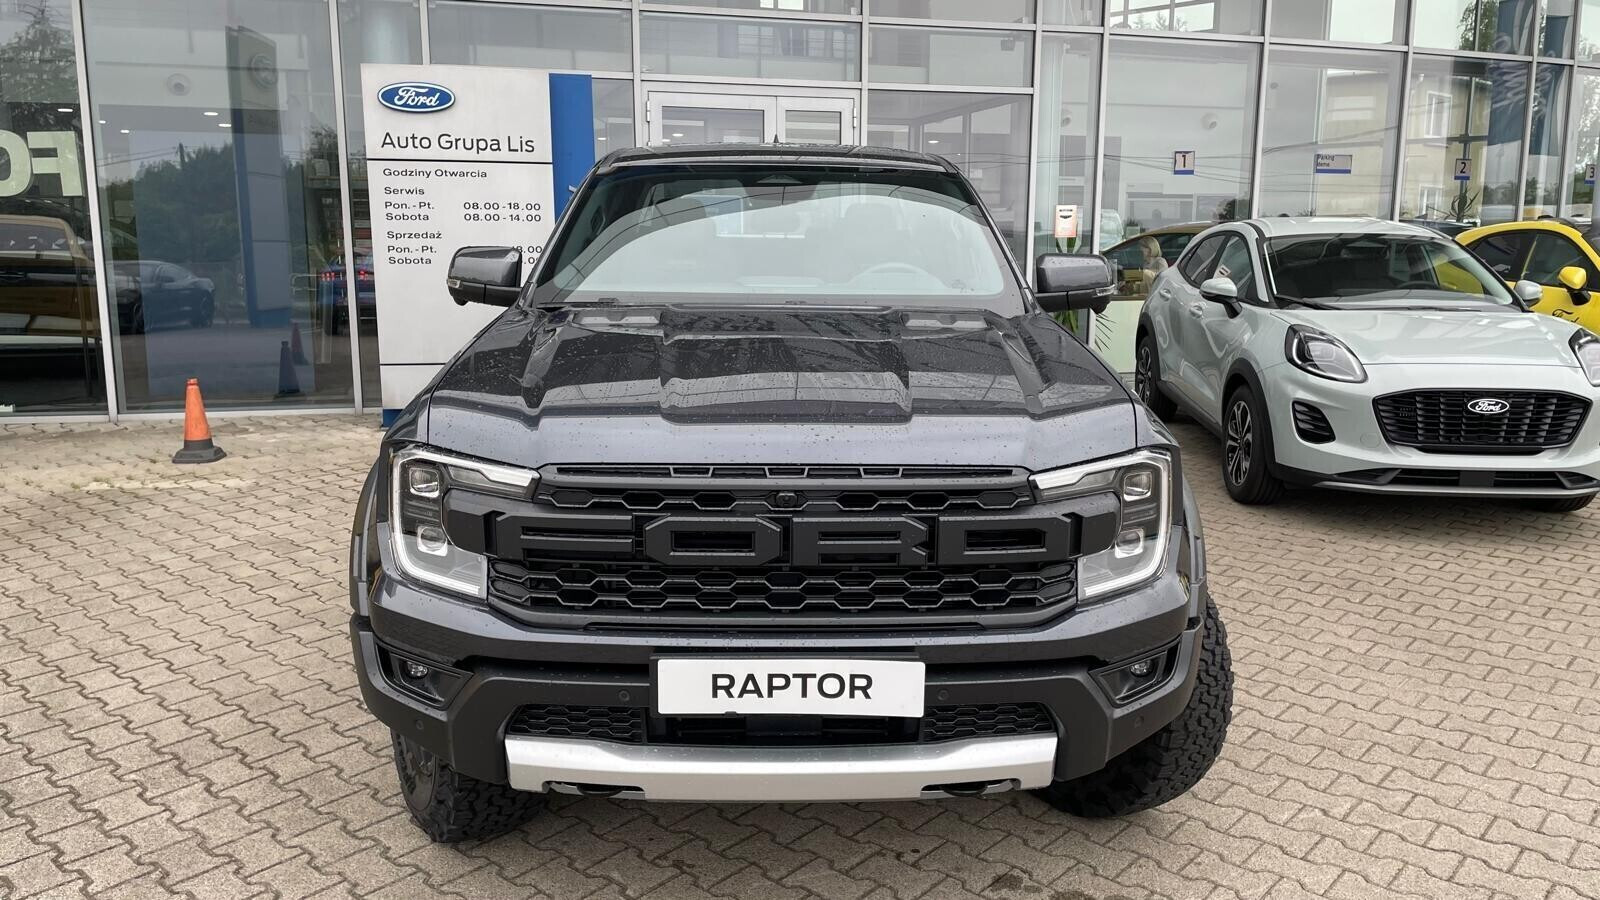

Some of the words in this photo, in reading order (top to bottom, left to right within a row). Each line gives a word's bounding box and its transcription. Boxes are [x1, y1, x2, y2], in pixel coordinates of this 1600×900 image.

[393, 86, 440, 108] Ford
[381, 131, 432, 149] Auto
[437, 133, 502, 154] Grupa
[507, 135, 535, 153] Lis
[1181, 154, 1187, 169] 1
[1459, 161, 1467, 174] 2
[382, 168, 432, 179] Godziny
[434, 169, 488, 179] Otwarcia
[1589, 166, 1595, 178] 3
[384, 186, 425, 196] Serwis
[385, 212, 430, 221] Sobota
[386, 230, 443, 241] Sprzedaż
[388, 256, 432, 265] Sobota
[1475, 400, 1503, 412] Ford
[496, 513, 1074, 567] FORD
[710, 673, 874, 700] RAPTOR
